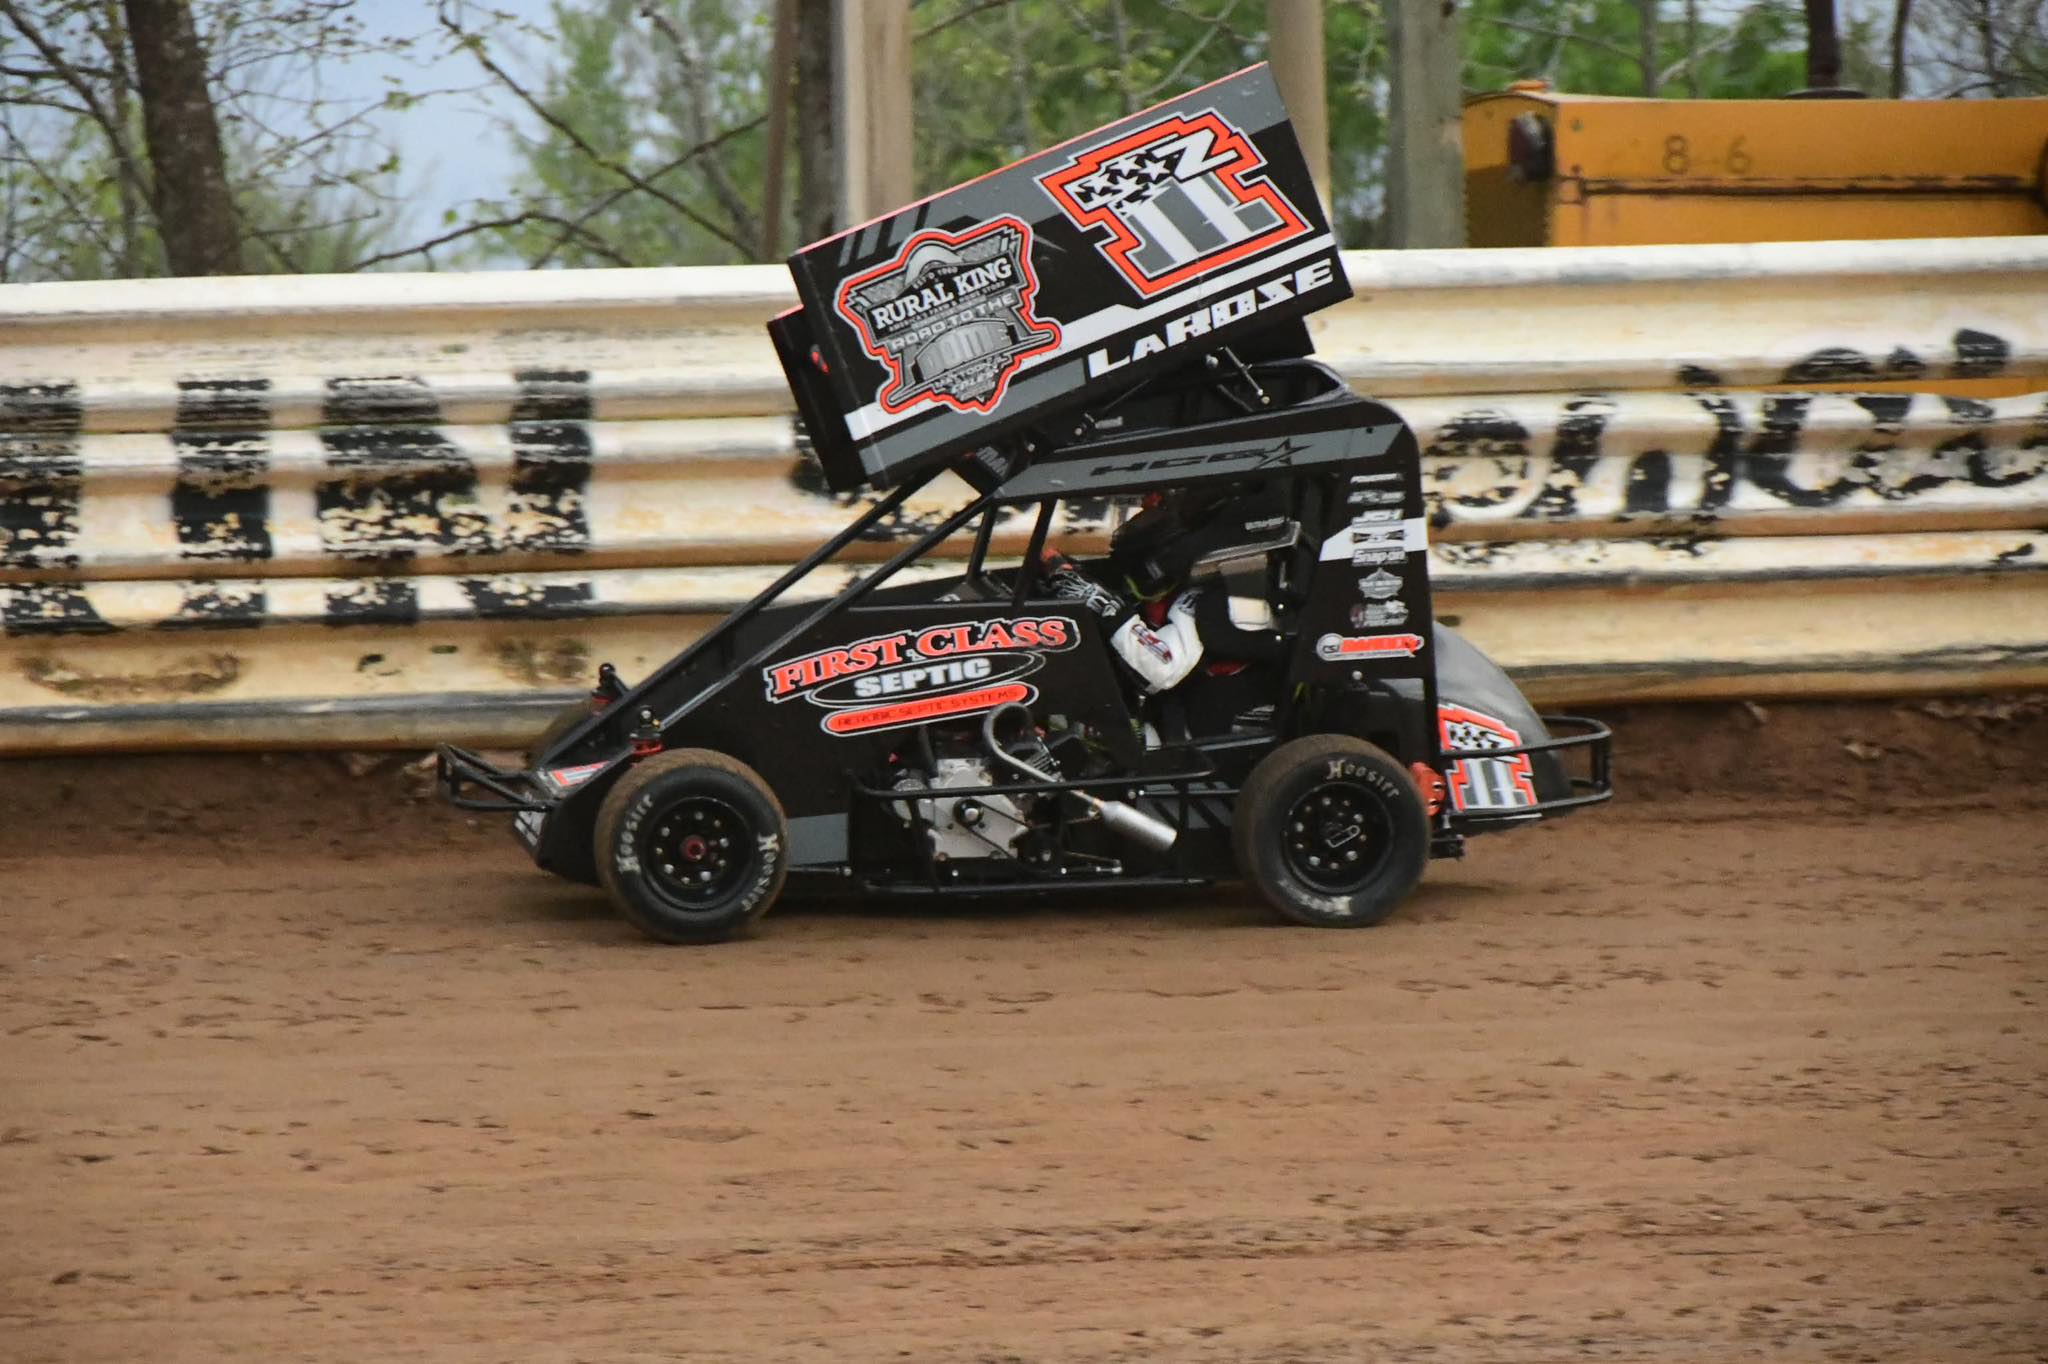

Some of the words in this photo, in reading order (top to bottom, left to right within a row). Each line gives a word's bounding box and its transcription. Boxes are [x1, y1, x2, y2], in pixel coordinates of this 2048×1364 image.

[871, 281, 954, 330] RURAL
[953, 257, 1013, 297] KING
[891, 322, 951, 350] ROAD
[951, 310, 976, 329] TO
[976, 292, 1016, 315] THE
[1088, 258, 1334, 379] LAROSE
[772, 634, 906, 695] FIRST
[916, 620, 1068, 657] CLASS
[854, 658, 992, 699] SEPTIC
